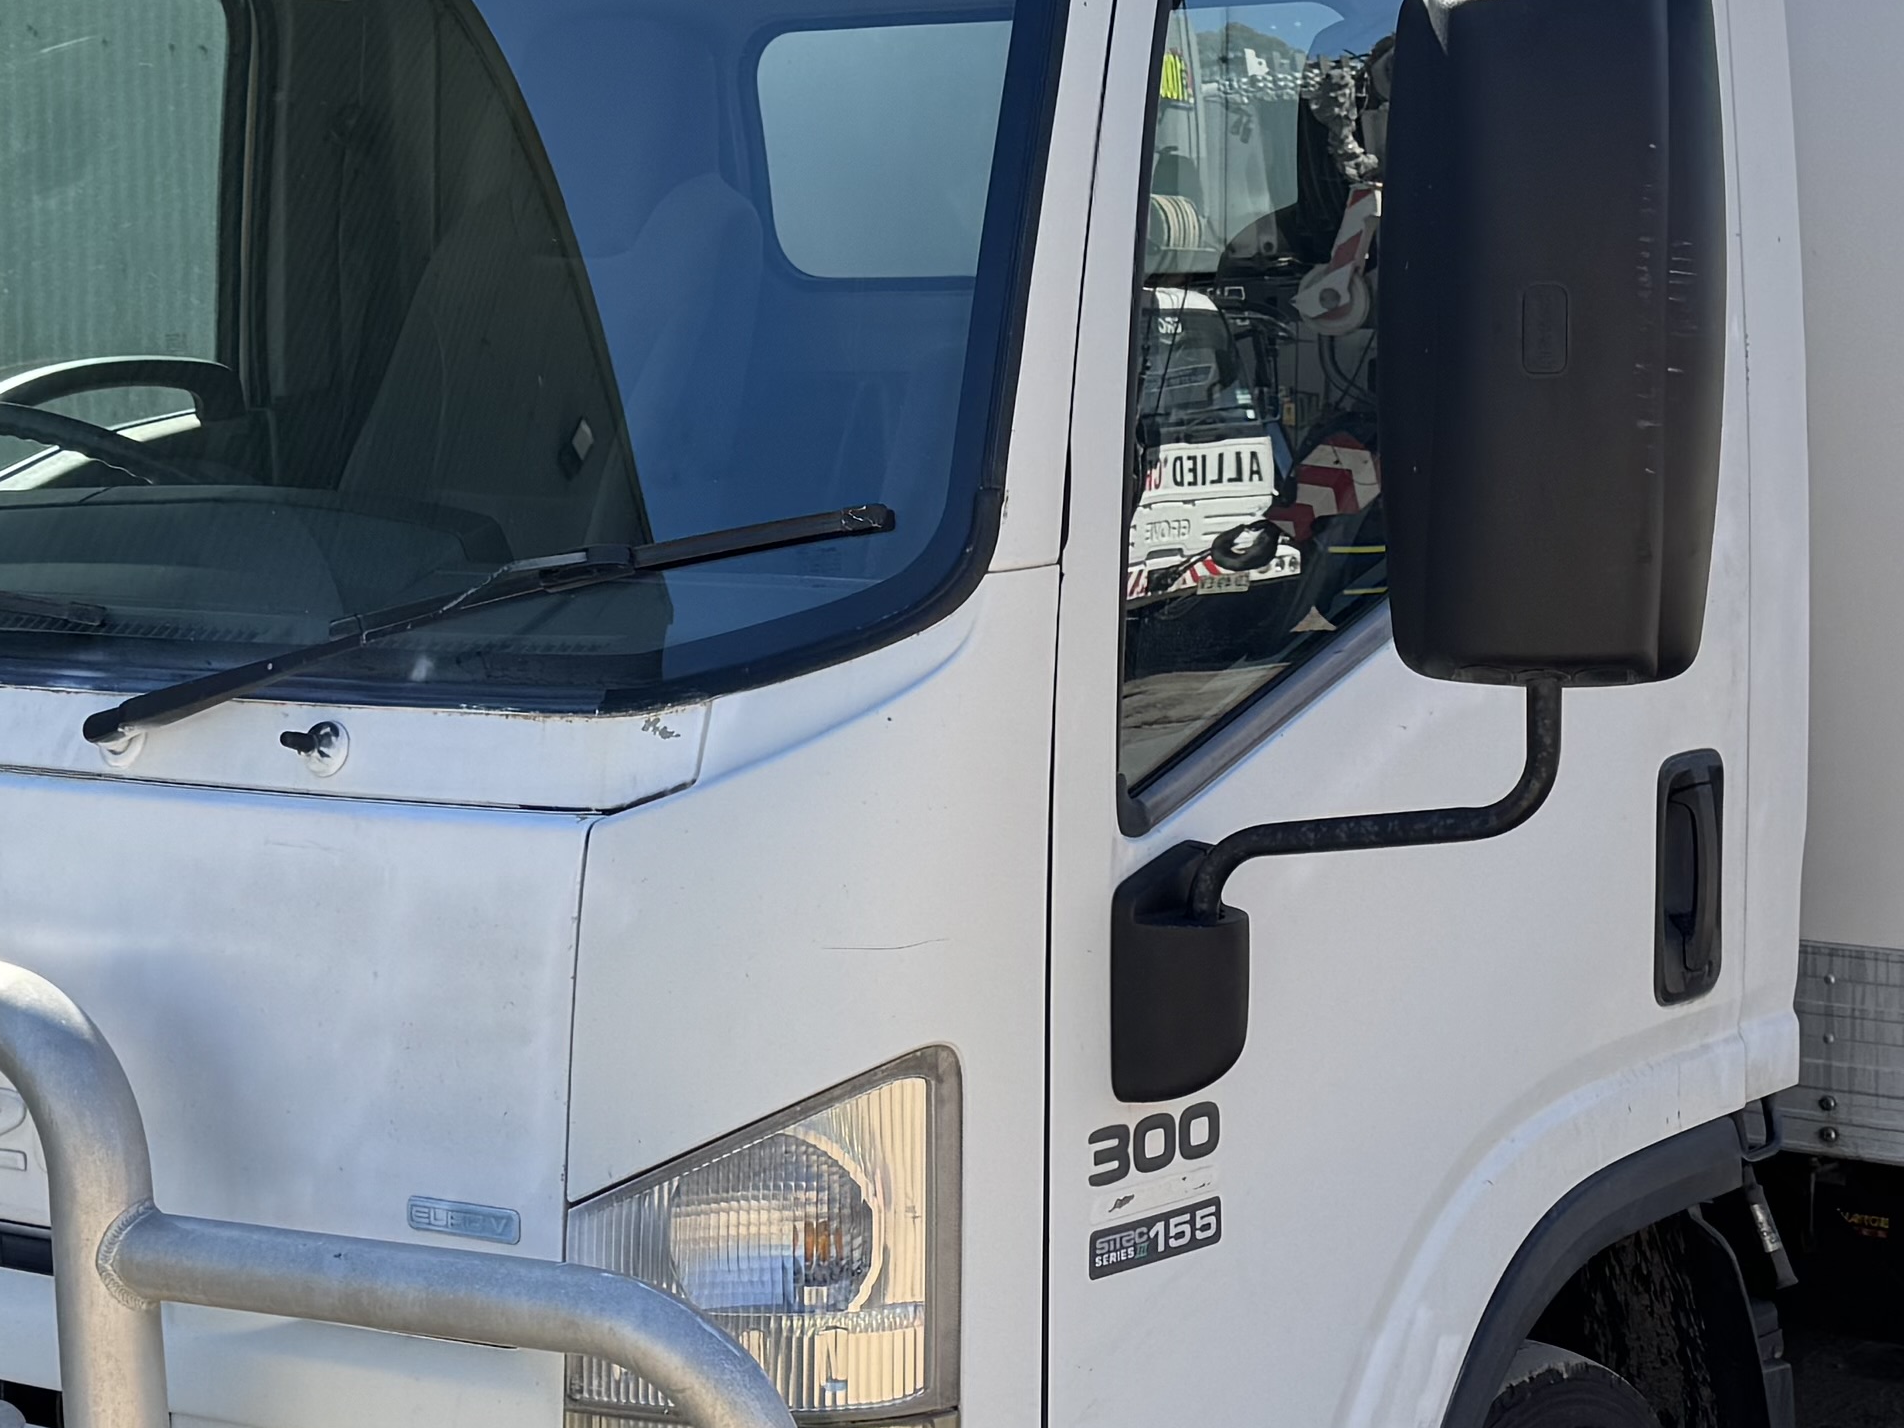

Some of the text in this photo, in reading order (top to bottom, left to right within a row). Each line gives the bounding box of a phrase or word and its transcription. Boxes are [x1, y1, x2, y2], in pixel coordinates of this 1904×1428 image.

[1088, 1101, 1220, 1187] 300
[1149, 1206, 1217, 1252] 155
[1095, 1247, 1135, 1267] SERIES
